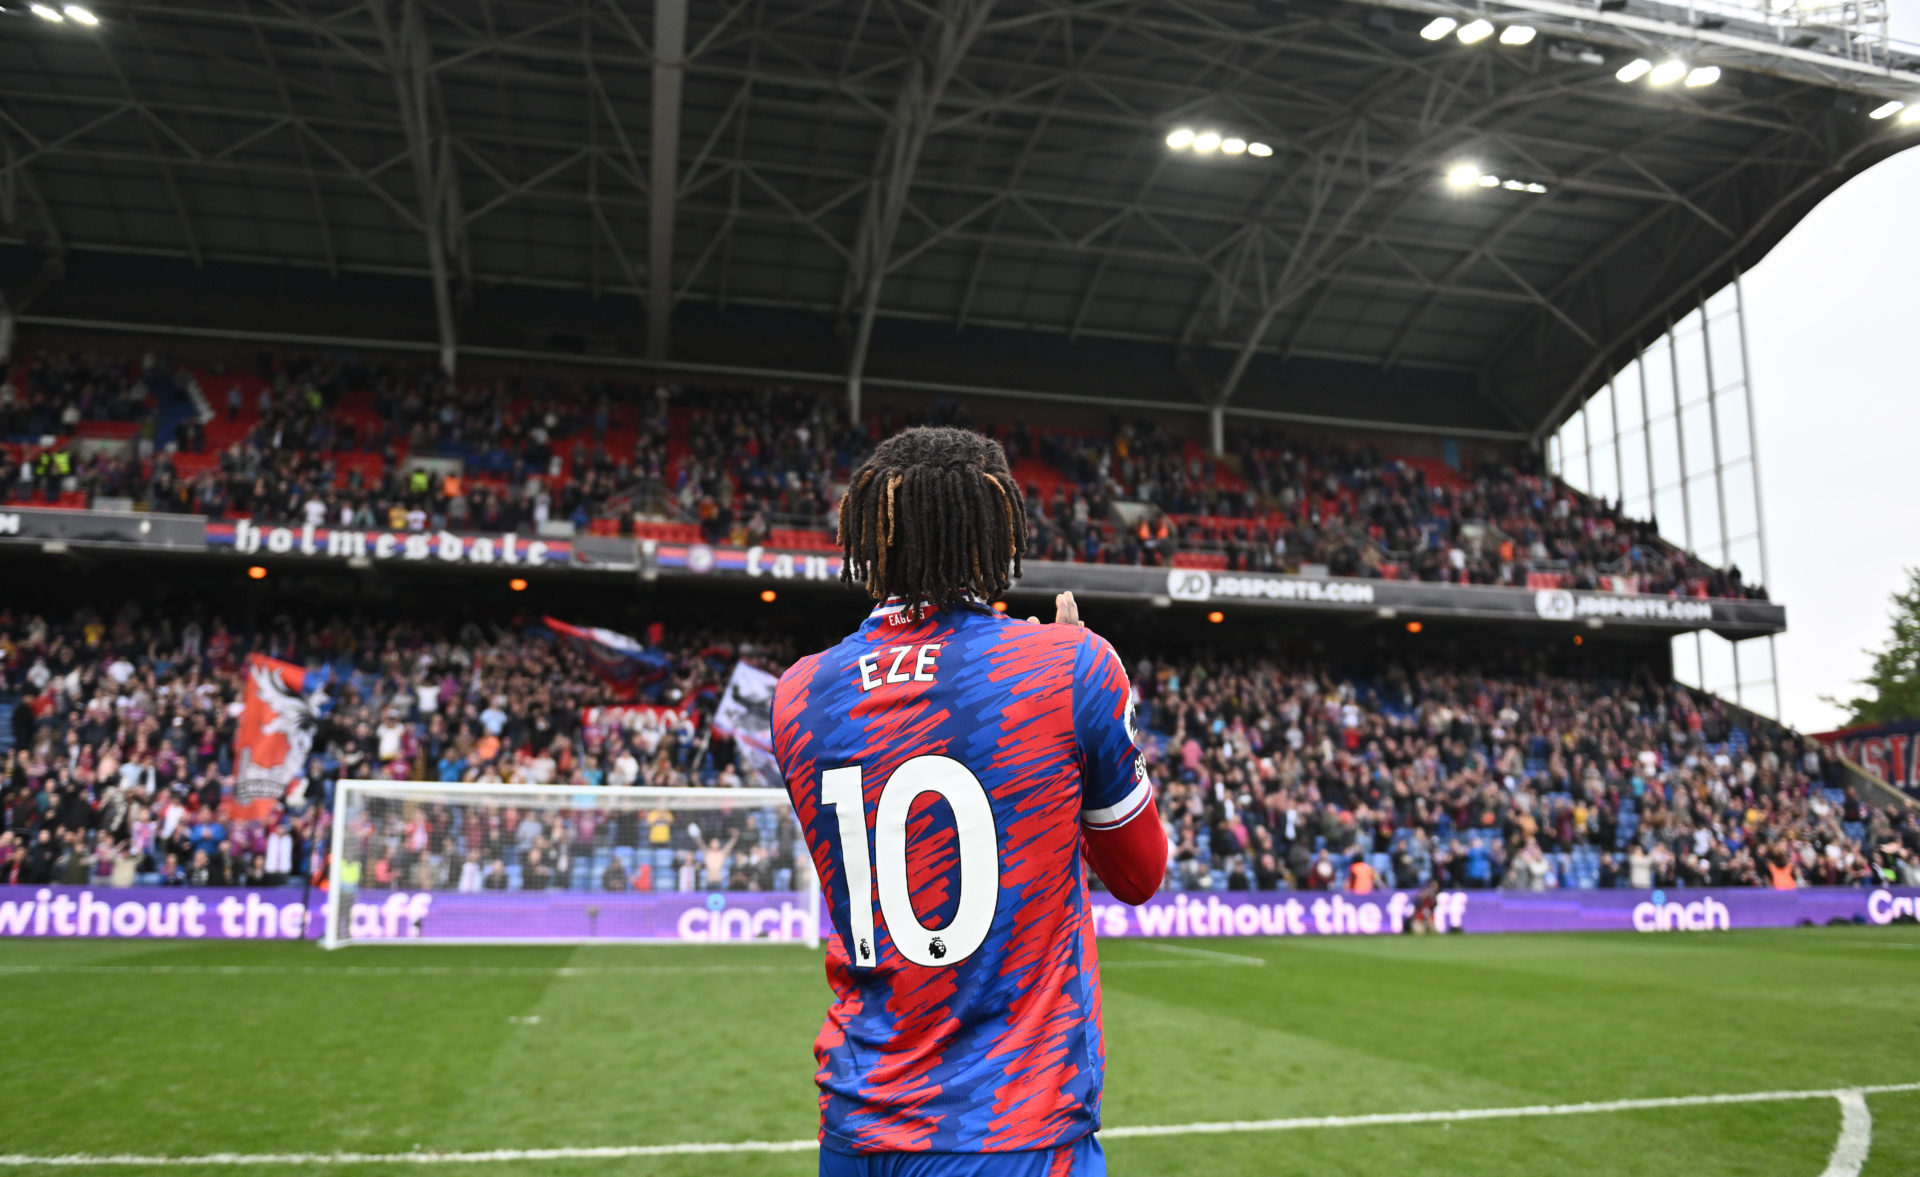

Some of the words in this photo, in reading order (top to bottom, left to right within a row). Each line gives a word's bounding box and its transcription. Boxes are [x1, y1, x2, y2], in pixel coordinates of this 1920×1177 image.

[234, 518, 550, 564] holmesdale
[1214, 577, 1374, 603] JDSPORTS.COM
[888, 608, 925, 627] EAGLS
[858, 643, 941, 692] EZE
[820, 754, 1000, 969] 10
[0, 888, 206, 937] without
[217, 893, 312, 938] the
[320, 892, 433, 938] aff
[677, 893, 816, 941] cinch
[1091, 904, 1129, 936] rs
[1134, 893, 1306, 936] without
[1311, 895, 1382, 934] the
[1386, 891, 1467, 933] fff
[1632, 890, 1730, 932] cinch
